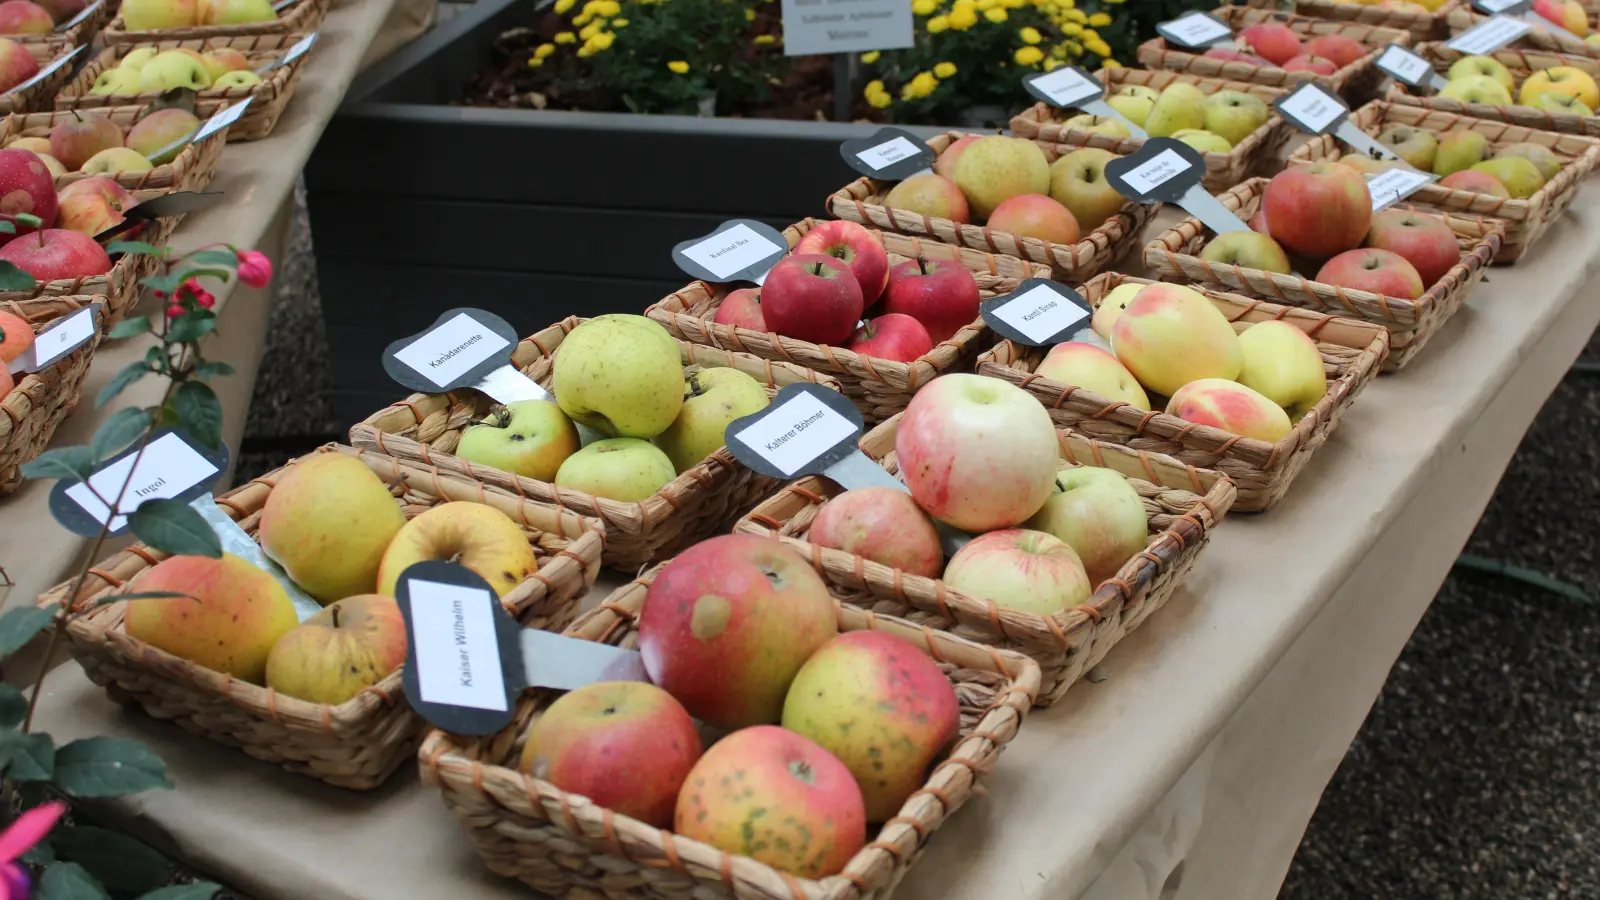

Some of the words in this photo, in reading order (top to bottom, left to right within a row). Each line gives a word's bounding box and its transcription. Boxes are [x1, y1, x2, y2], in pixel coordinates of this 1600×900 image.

[709, 243, 737, 259] Kardinal
[735, 238, 749, 247] Bea
[1021, 306, 1042, 321] Kantil
[1041, 301, 1058, 313] Sinap
[428, 334, 483, 368] Kanadarenette
[765, 428, 798, 451] Kalterer
[793, 409, 825, 432] Böhmer
[134, 477, 166, 498] Ingol
[451, 600, 467, 646] Wilhelm
[458, 649, 473, 687] Kaiser
